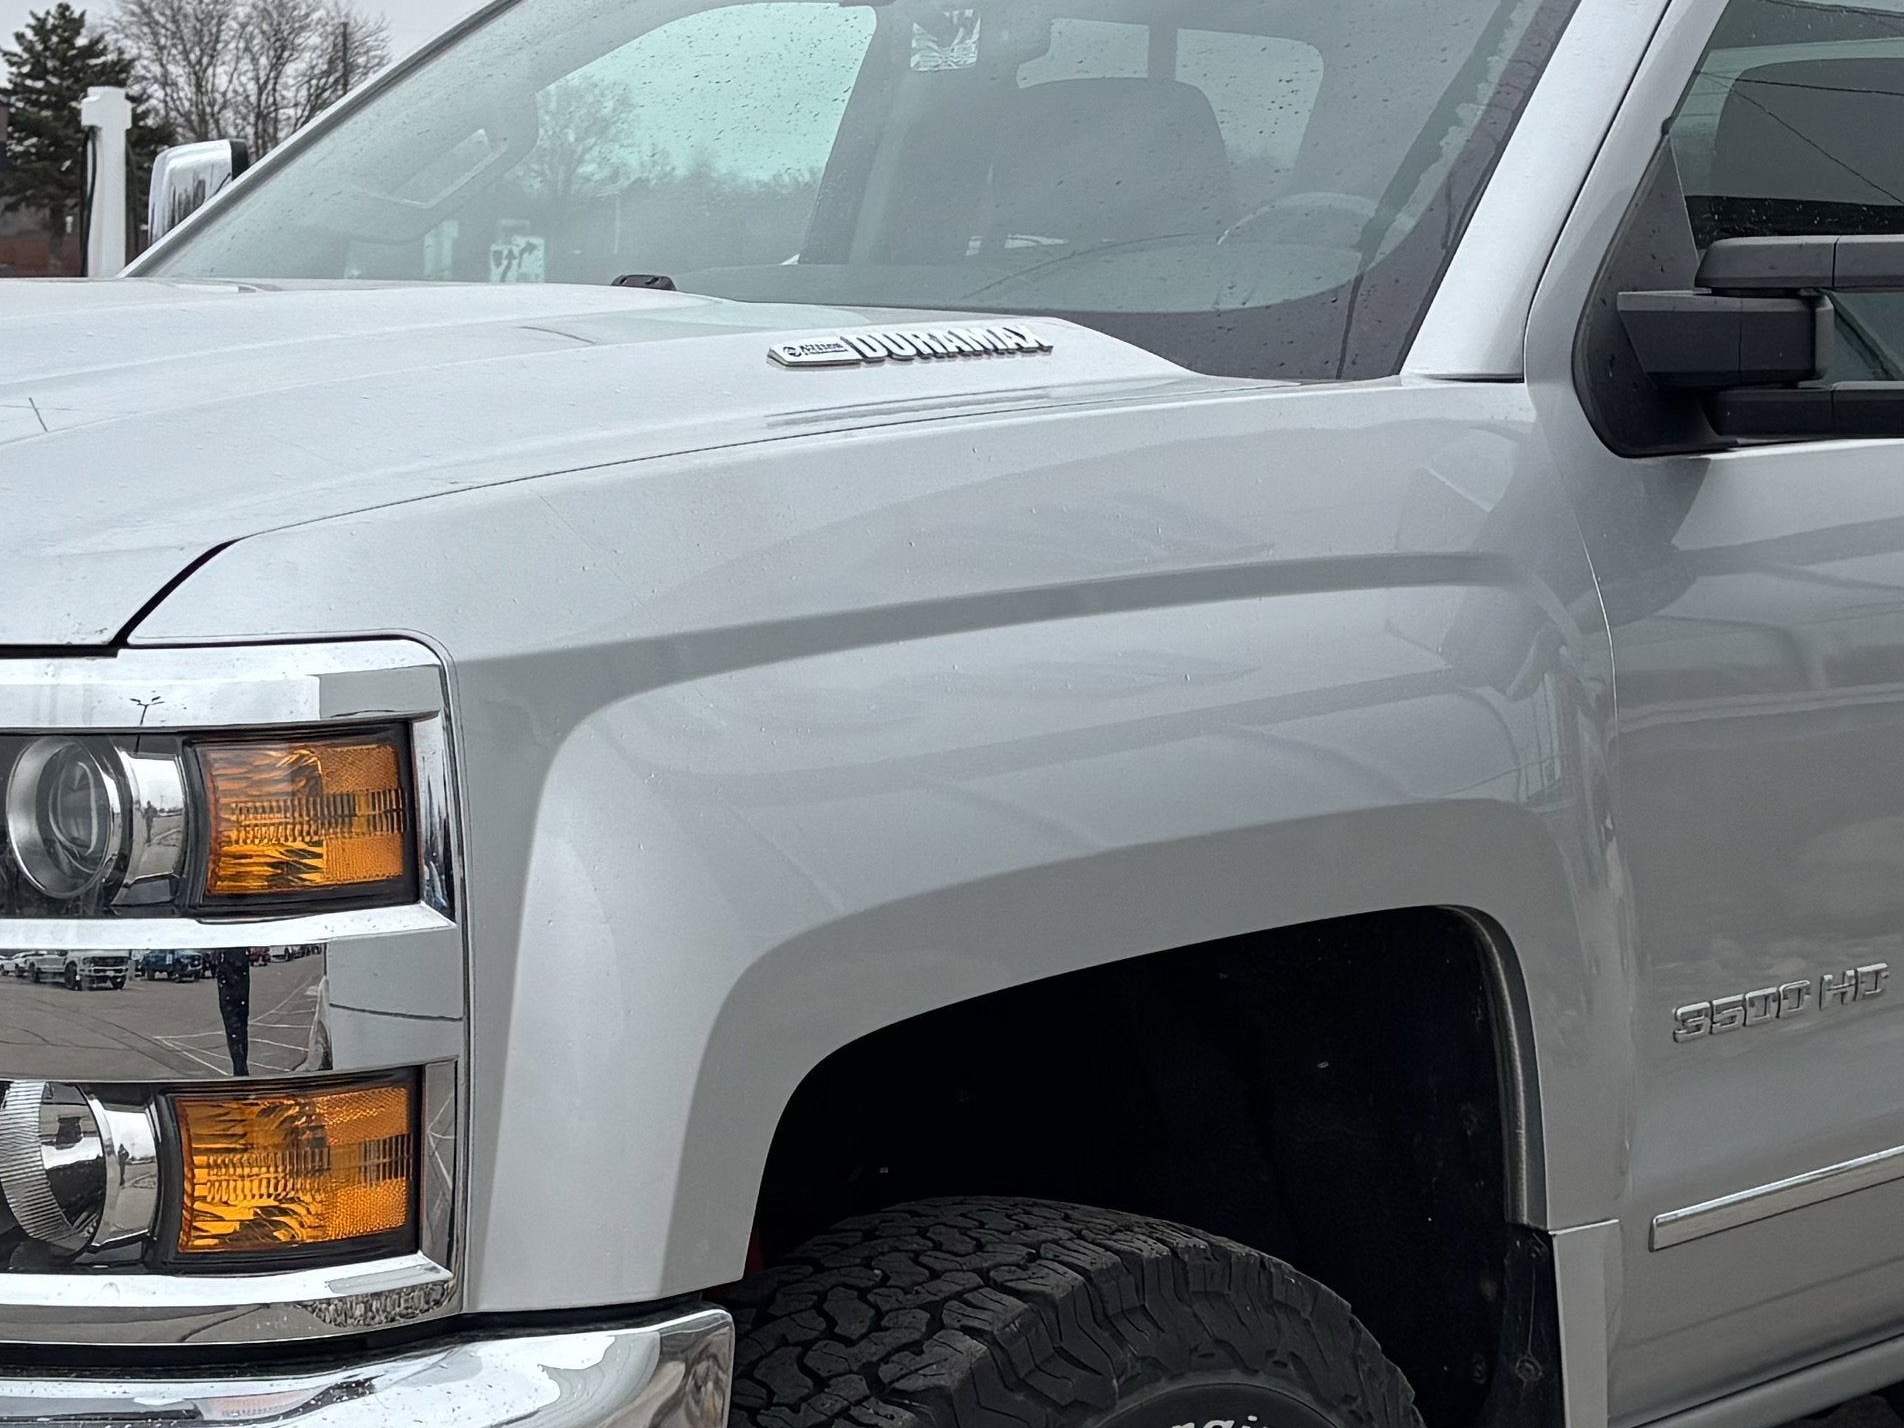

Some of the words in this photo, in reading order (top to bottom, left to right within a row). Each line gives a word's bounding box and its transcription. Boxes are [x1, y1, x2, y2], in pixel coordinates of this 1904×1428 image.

[842, 325, 1054, 362] DURAMAX
[1672, 979, 1811, 1044] 3500
[1818, 962, 1890, 1011] HD
